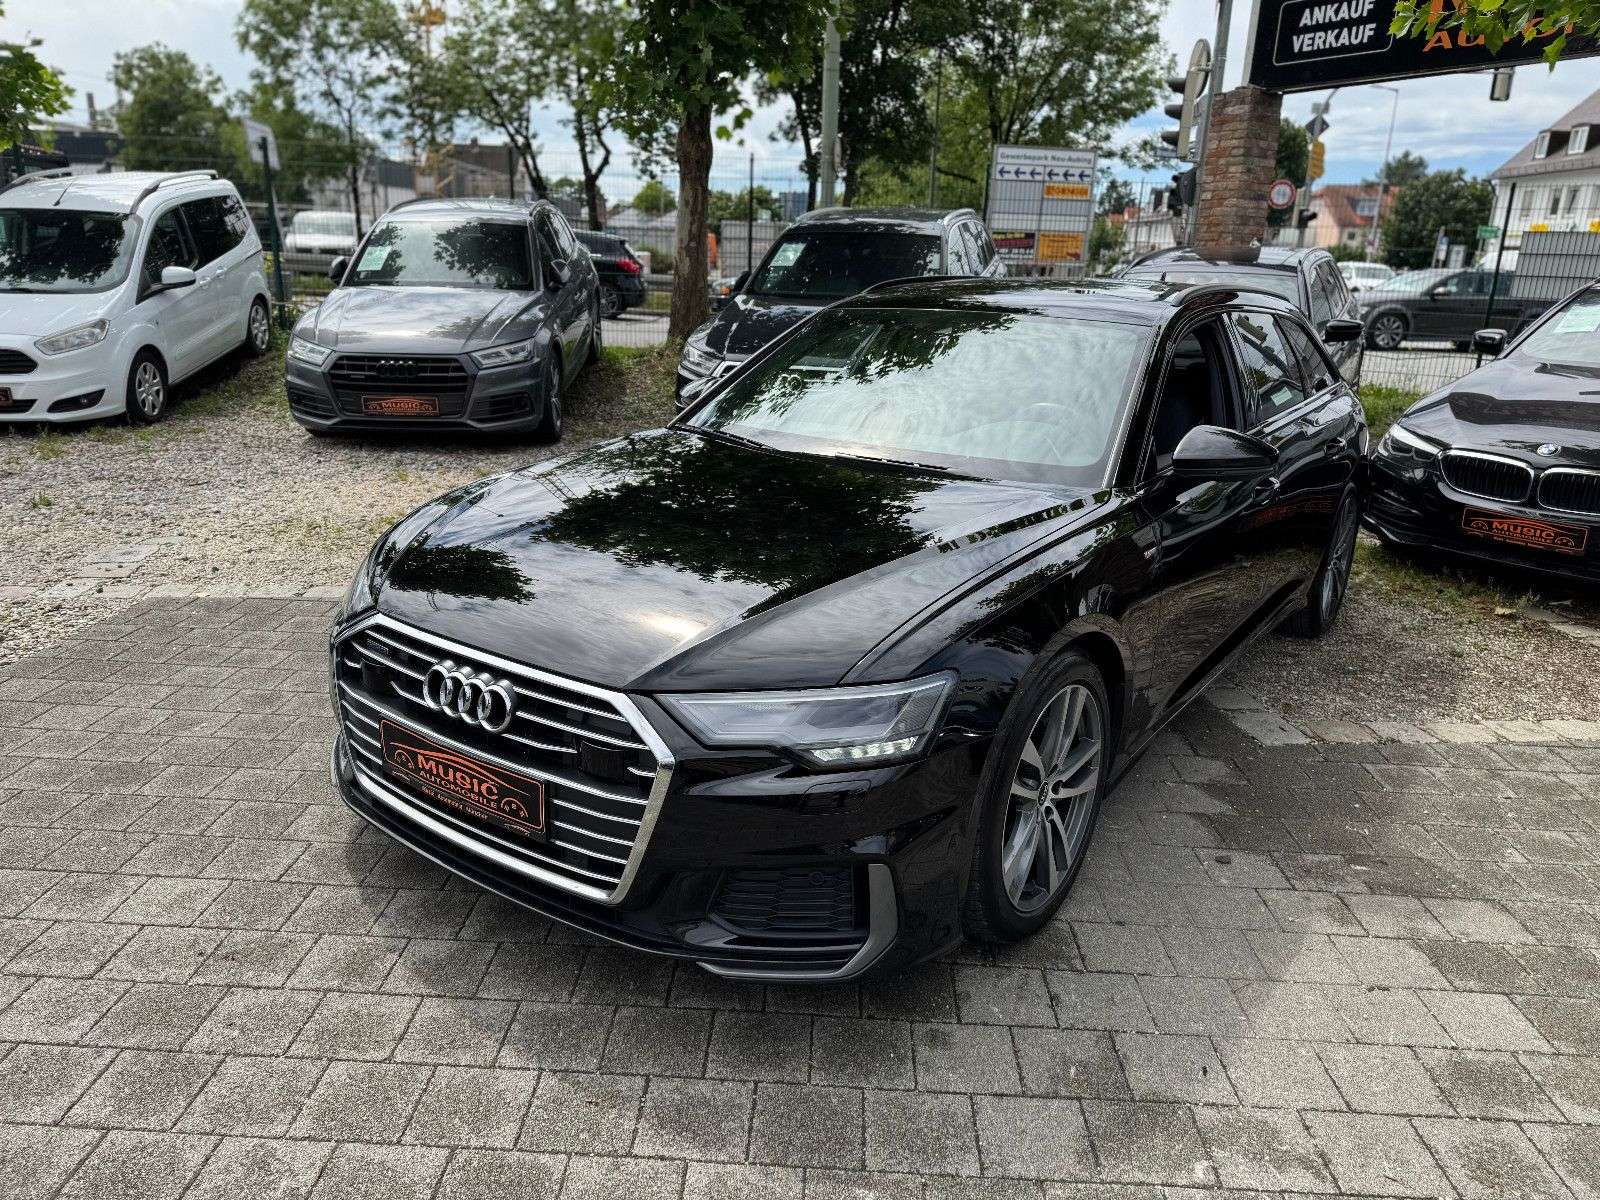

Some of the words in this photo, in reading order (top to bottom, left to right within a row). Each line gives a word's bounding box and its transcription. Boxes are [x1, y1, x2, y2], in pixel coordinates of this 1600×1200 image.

[1299, 0, 1374, 27] ANKAUF
[1292, 24, 1376, 53] VERKAUF
[1492, 521, 1554, 539] MUSIC
[417, 754, 498, 800] MUSIC
[419, 772, 497, 809] AUTOMOBILE
